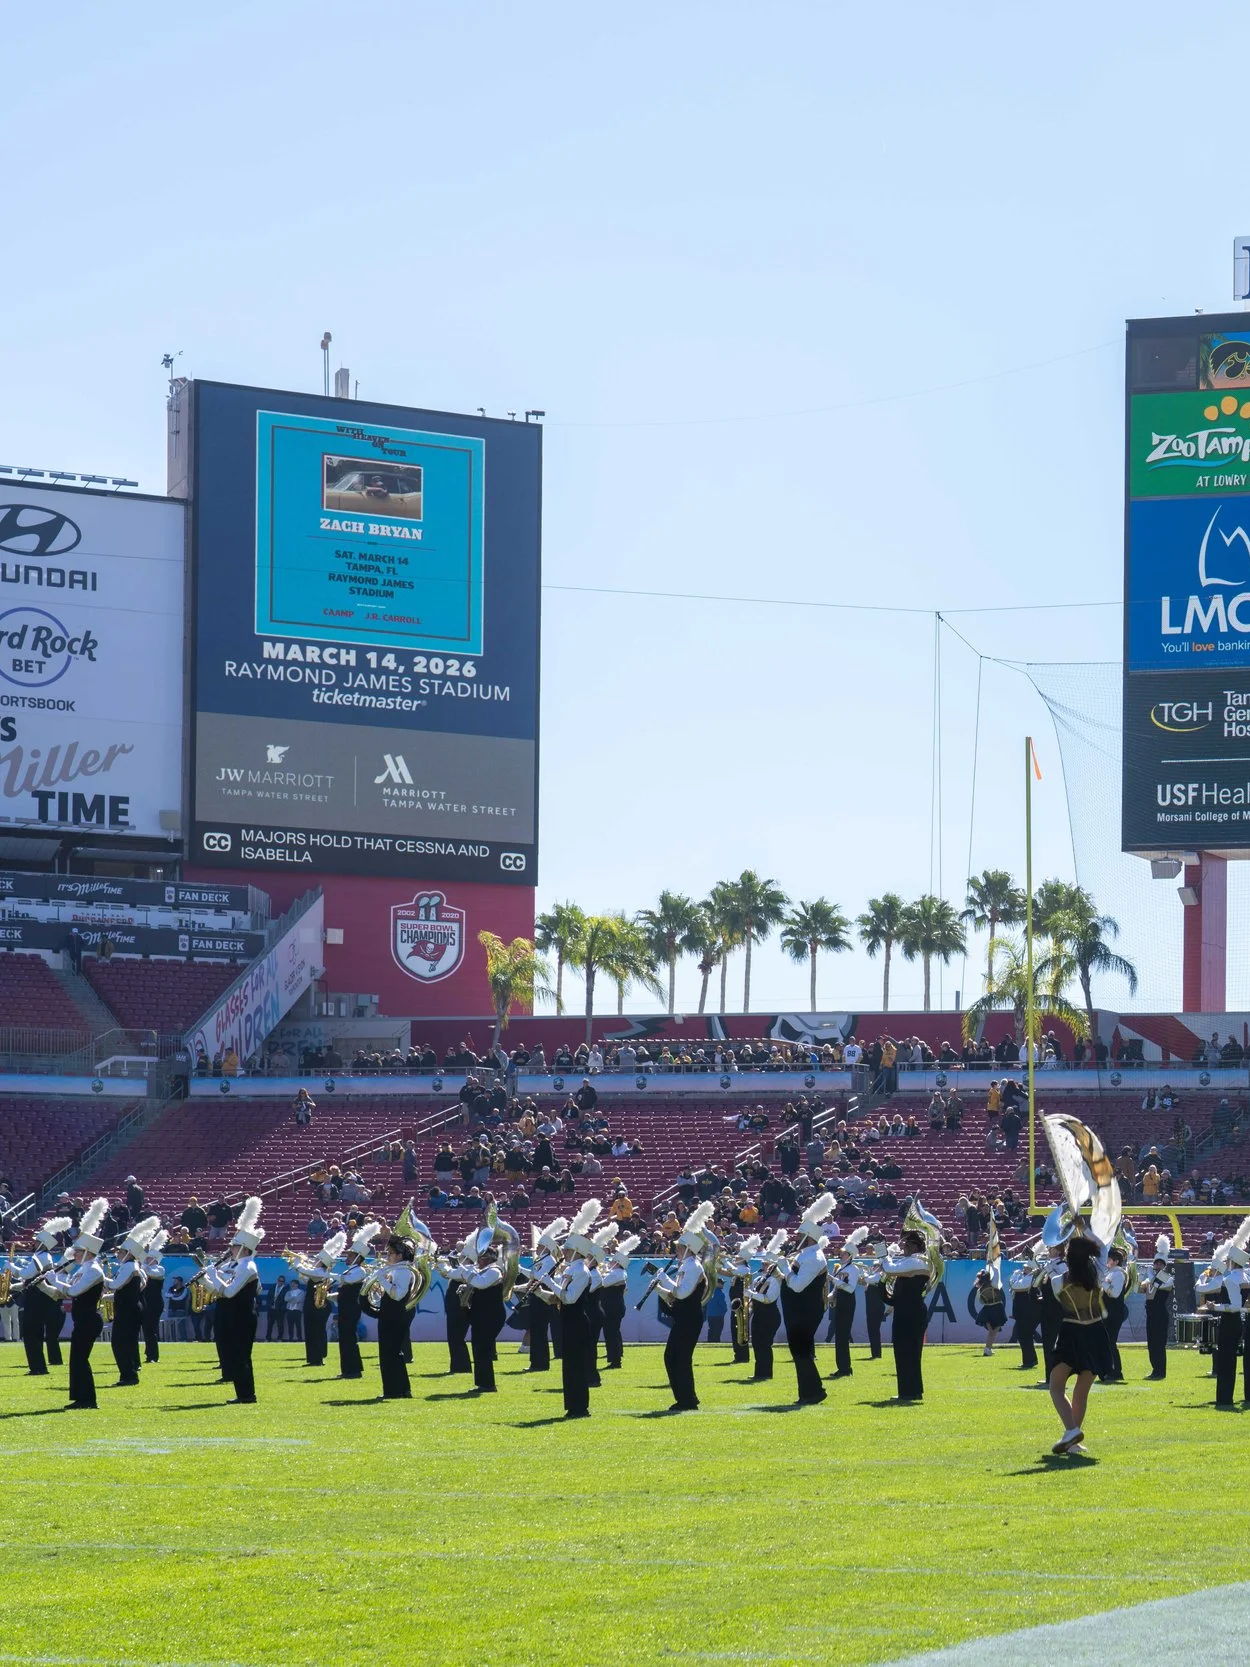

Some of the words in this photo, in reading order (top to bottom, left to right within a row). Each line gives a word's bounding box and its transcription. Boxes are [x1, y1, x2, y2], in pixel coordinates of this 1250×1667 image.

[1196, 476, 1210, 488] AT
[1213, 474, 1247, 487] LOWRY
[320, 518, 364, 534] ZACH
[368, 523, 423, 540] BRYAN
[335, 550, 356, 559] SAT.
[358, 552, 395, 564] MARCH
[397, 557, 409, 565] 14
[1, 562, 97, 591] UNDAI
[346, 562, 384, 574] TAMPA,
[386, 567, 398, 575] FL
[328, 573, 379, 585] RAYMOND
[381, 579, 414, 589] JAMES
[349, 586, 394, 598] STADIUM
[323, 608, 354, 618] CAAMP
[382, 614, 422, 625] CARROLL
[31, 625, 98, 662] Rock
[1161, 642, 1190, 653] You'll
[1192, 642, 1215, 652] love
[12, 659, 46, 674] BET
[262, 641, 356, 667] MARCH
[366, 652, 405, 674] 14,
[412, 656, 477, 678] 2026
[225, 660, 337, 686] RAYMOND
[343, 673, 412, 693] JAMES
[419, 679, 511, 701] STADIUM
[0, 695, 76, 712] ORTSBOOK
[312, 688, 422, 711] ticketmaster
[1159, 702, 1213, 723] TGH
[0, 716, 17, 742] S
[215, 768, 244, 782] JW
[248, 770, 335, 789] MARRIOTT
[222, 788, 253, 797] TAMPA
[257, 791, 289, 800] WATER
[292, 793, 329, 803] STREET
[383, 787, 447, 799] MARRIOTT
[1157, 783, 1199, 807] USF
[31, 790, 130, 826] TIME
[383, 799, 423, 810] TAMPA
[427, 802, 468, 813] WATER
[472, 805, 517, 817] STREET
[1157, 812, 1192, 823] Morsani
[1195, 811, 1228, 823] College
[1231, 811, 1240, 820] of
[205, 835, 229, 850] CC
[241, 829, 307, 847] MAJORS
[309, 834, 352, 850] HOLD
[354, 837, 394, 852] THAT
[395, 839, 457, 856] CESSNA
[457, 843, 490, 858] AND
[241, 847, 313, 863] ISABELLA
[502, 855, 525, 869] CC
[103, 887, 124, 895] TIME
[179, 891, 199, 901] FAN
[201, 893, 229, 902] DECK
[397, 909, 416, 917] 2002
[400, 923, 429, 931] SUPER
[430, 924, 456, 932] BOWL
[116, 935, 136, 944] TIME
[192, 939, 213, 949] FAN
[216, 941, 245, 951] DECK
[400, 930, 456, 946] CHAMPIONS
